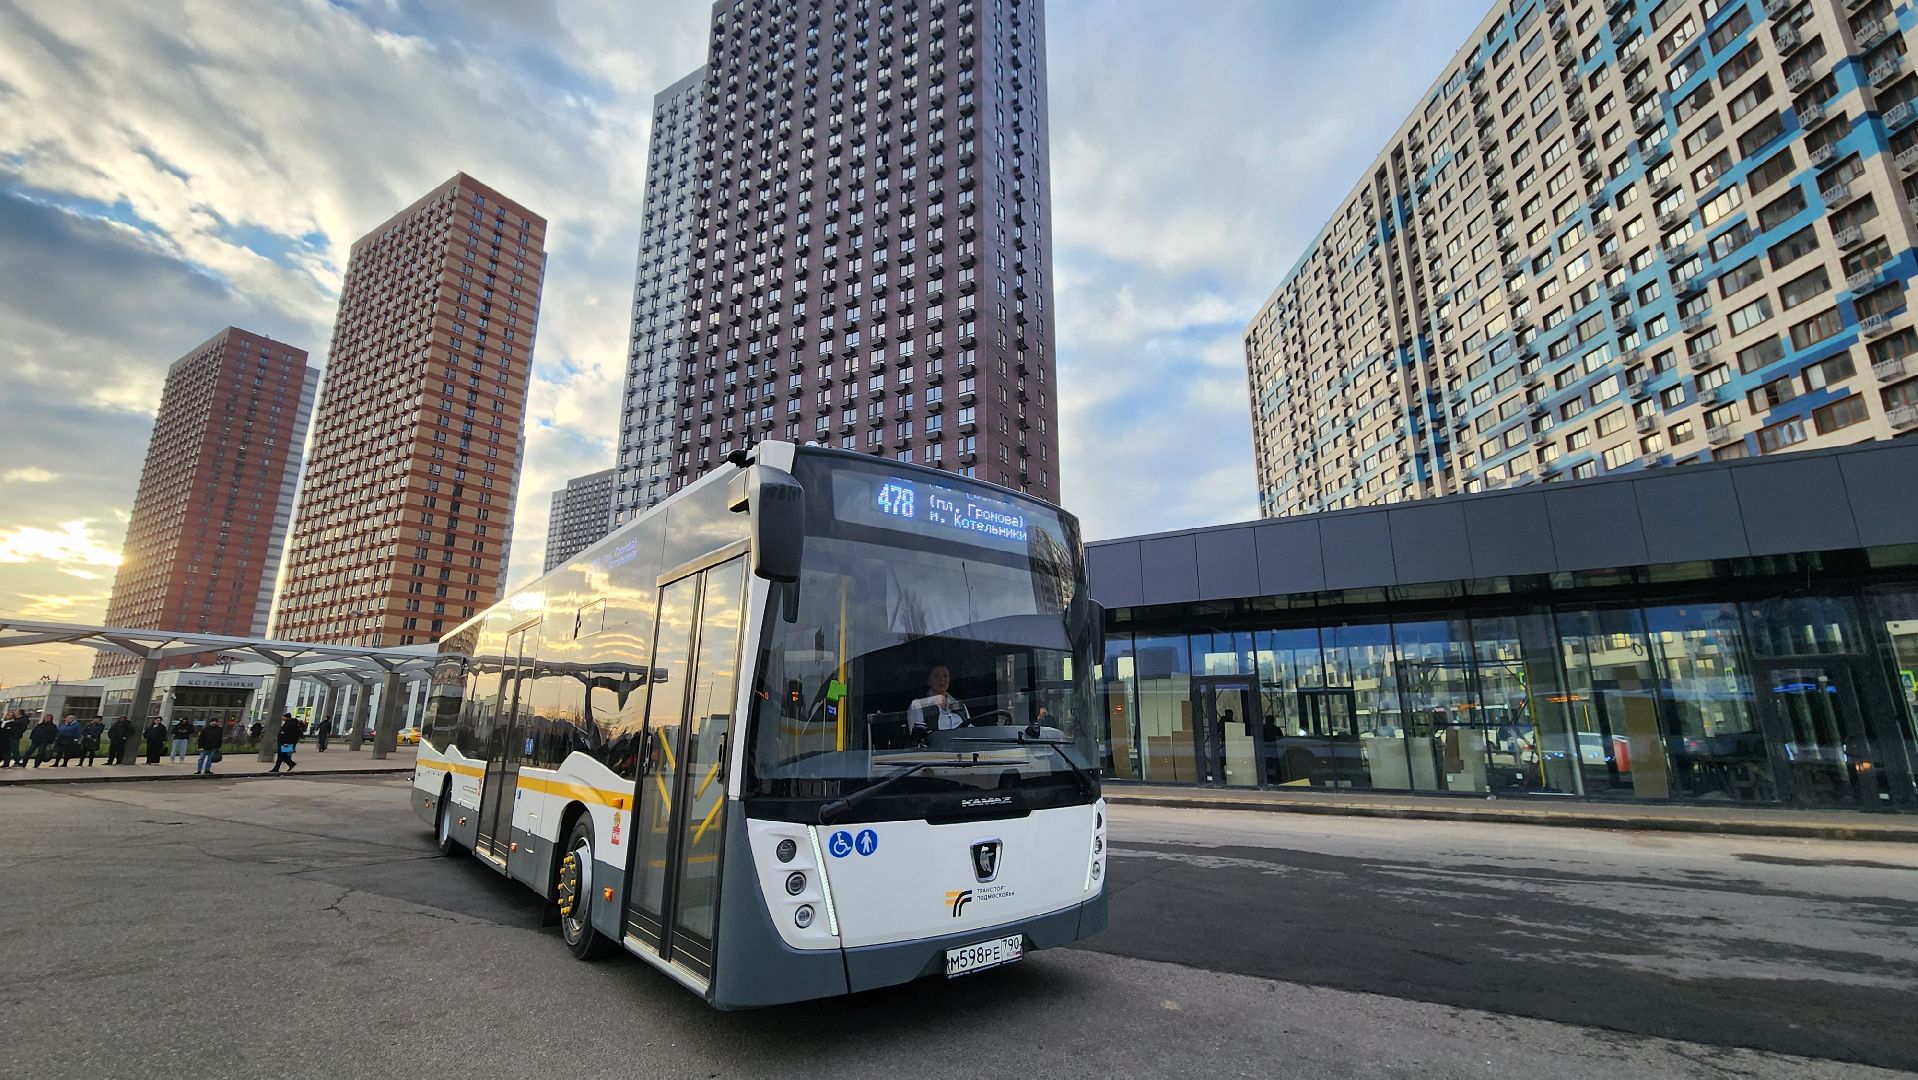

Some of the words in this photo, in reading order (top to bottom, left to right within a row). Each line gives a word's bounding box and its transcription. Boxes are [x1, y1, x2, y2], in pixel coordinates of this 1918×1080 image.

[877, 483, 914, 518] 478
[929, 494, 960, 514] (пл.
[967, 503, 1024, 528] Громова)
[954, 513, 1028, 541] Котельники
[1002, 936, 1020, 952] 790
